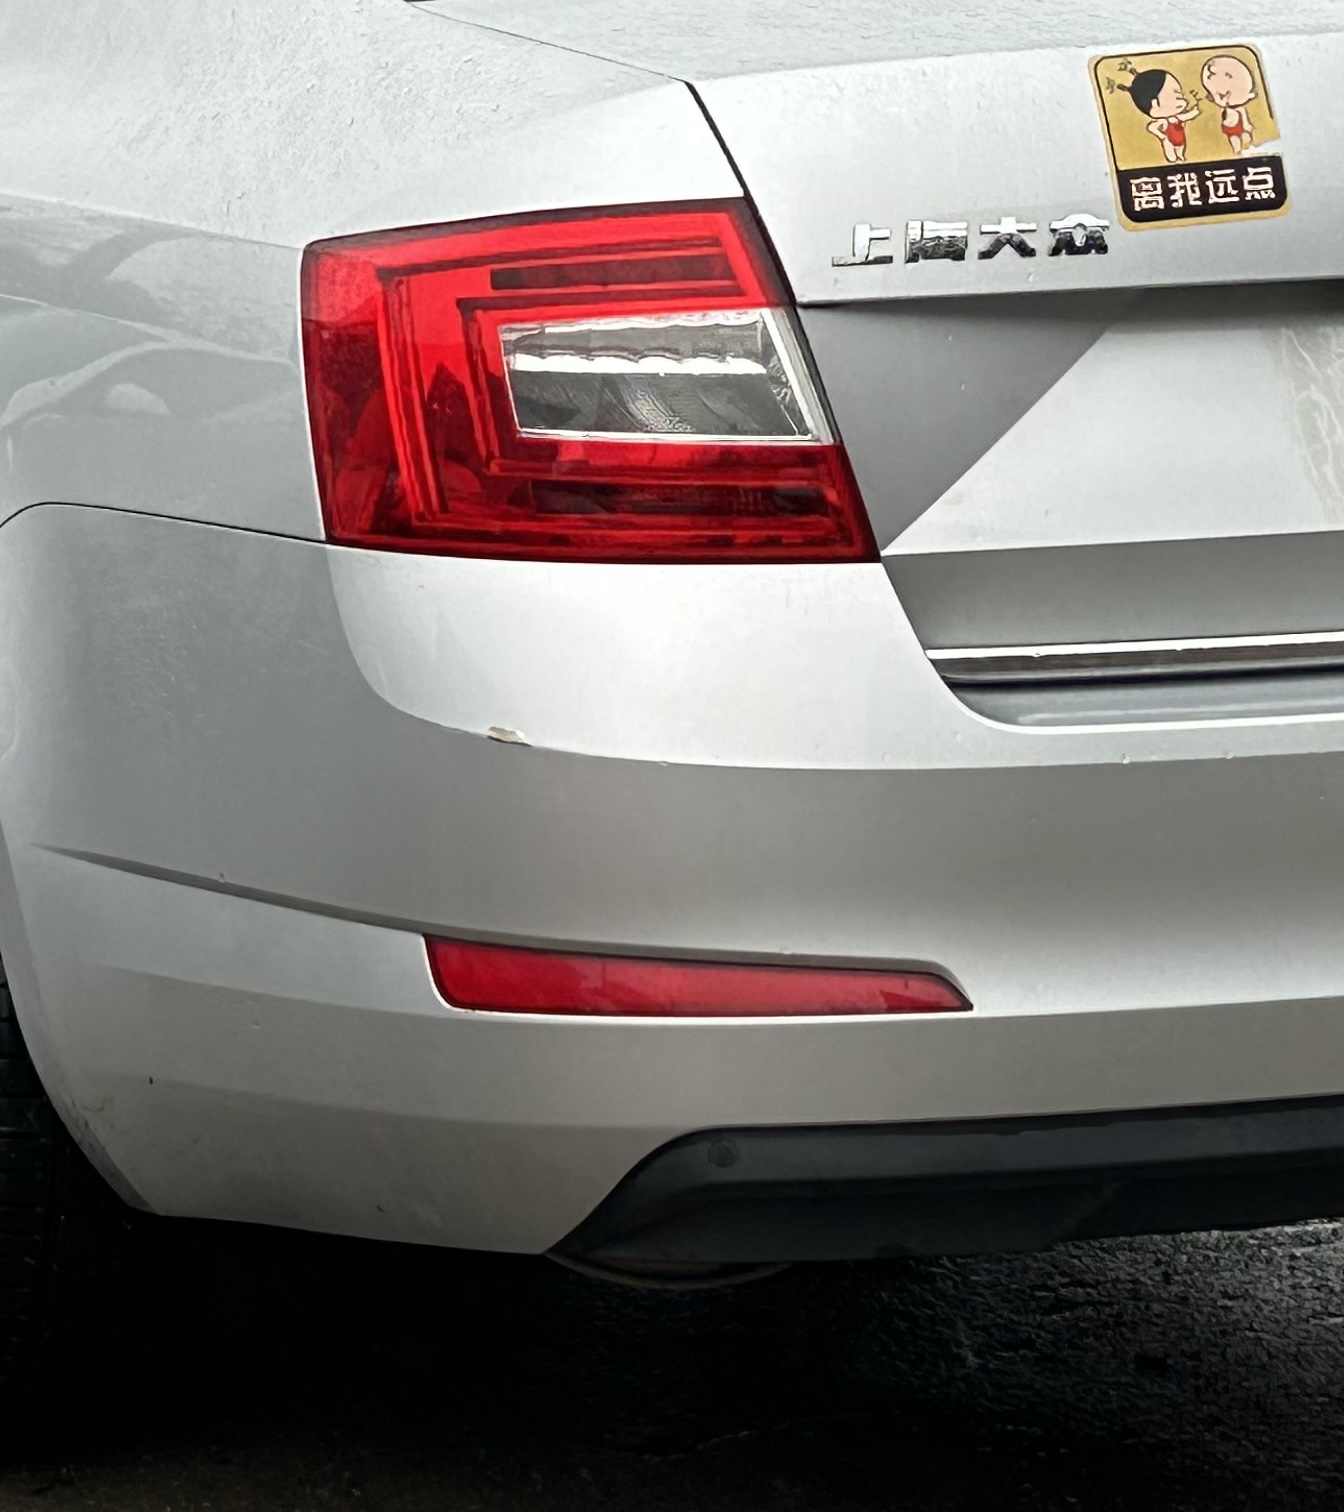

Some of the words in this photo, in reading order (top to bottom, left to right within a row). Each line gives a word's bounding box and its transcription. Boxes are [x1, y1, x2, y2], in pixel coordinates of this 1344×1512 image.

[1130, 166, 1276, 212] 离我远点
[831, 212, 1111, 268] 上海大众
